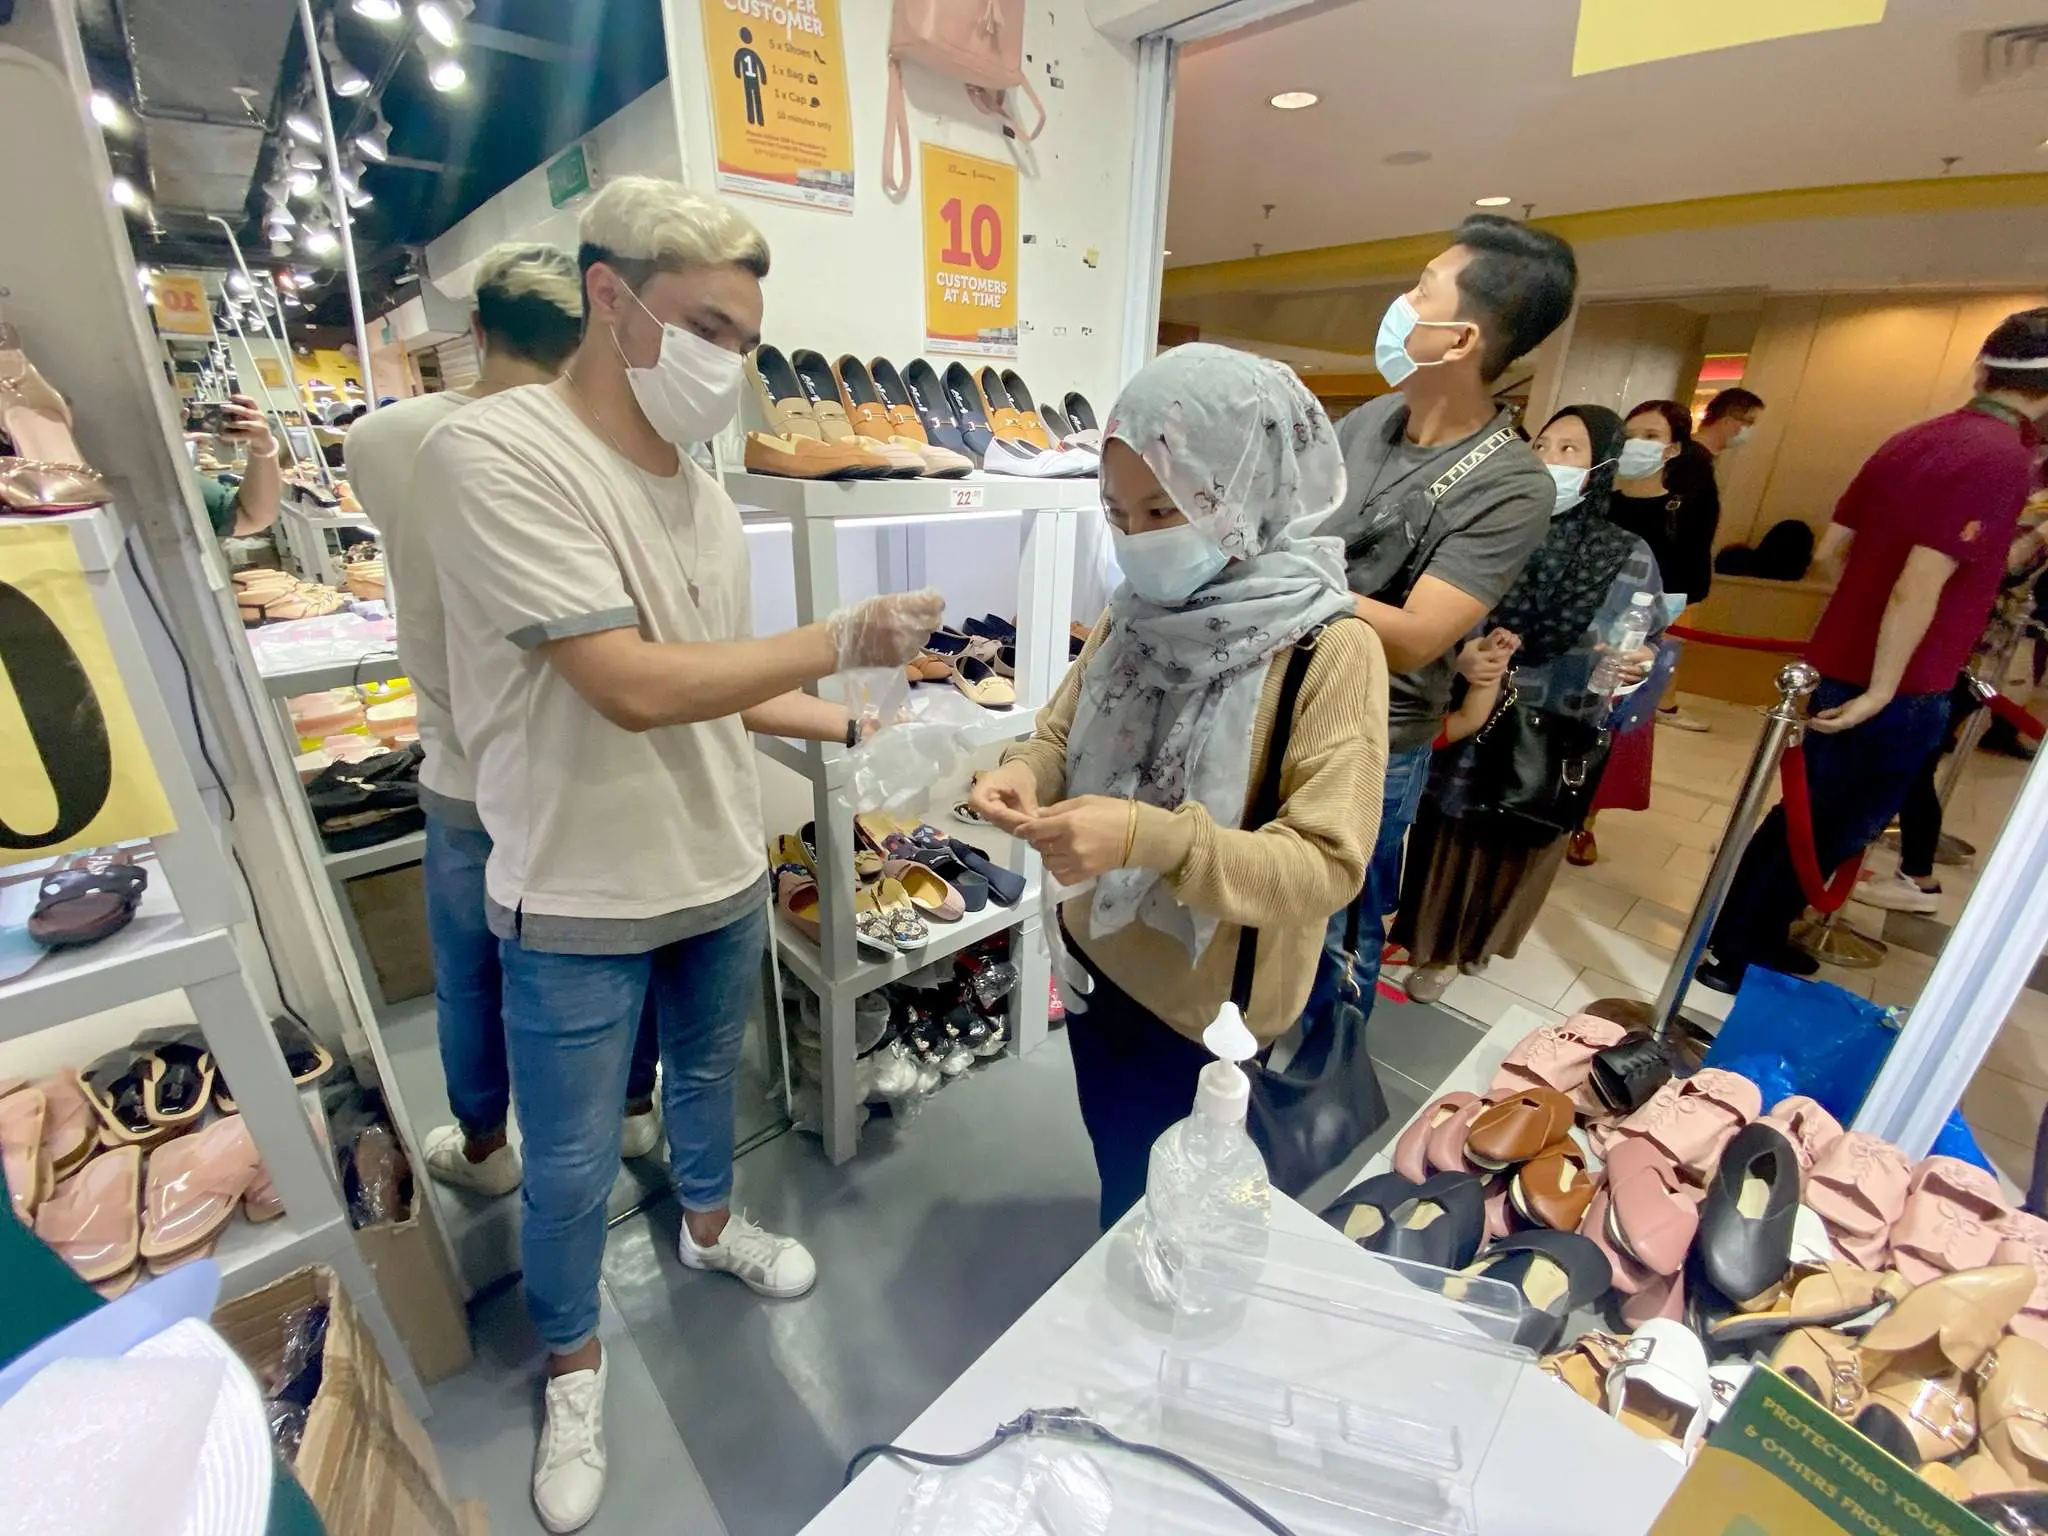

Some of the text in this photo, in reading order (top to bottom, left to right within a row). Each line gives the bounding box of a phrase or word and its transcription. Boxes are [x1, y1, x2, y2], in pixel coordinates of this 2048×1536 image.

[723, 0, 824, 38] CUSTOMER
[768, 38, 776, 50] 5
[784, 42, 813, 59] Shoes
[743, 55, 757, 78] 1
[786, 68, 804, 83] Bag
[788, 92, 807, 106] Cap
[940, 198, 1002, 271] 10
[936, 272, 1008, 294] CUSTOMERS
[943, 288, 1002, 309] AT A TIME
[1447, 451, 1487, 482] FILA
[956, 490, 972, 506] 22
[1762, 1396, 1889, 1495] PROTECTING
[1744, 1423, 1759, 1439] &
[1761, 1436, 1837, 1500] OTHERS
